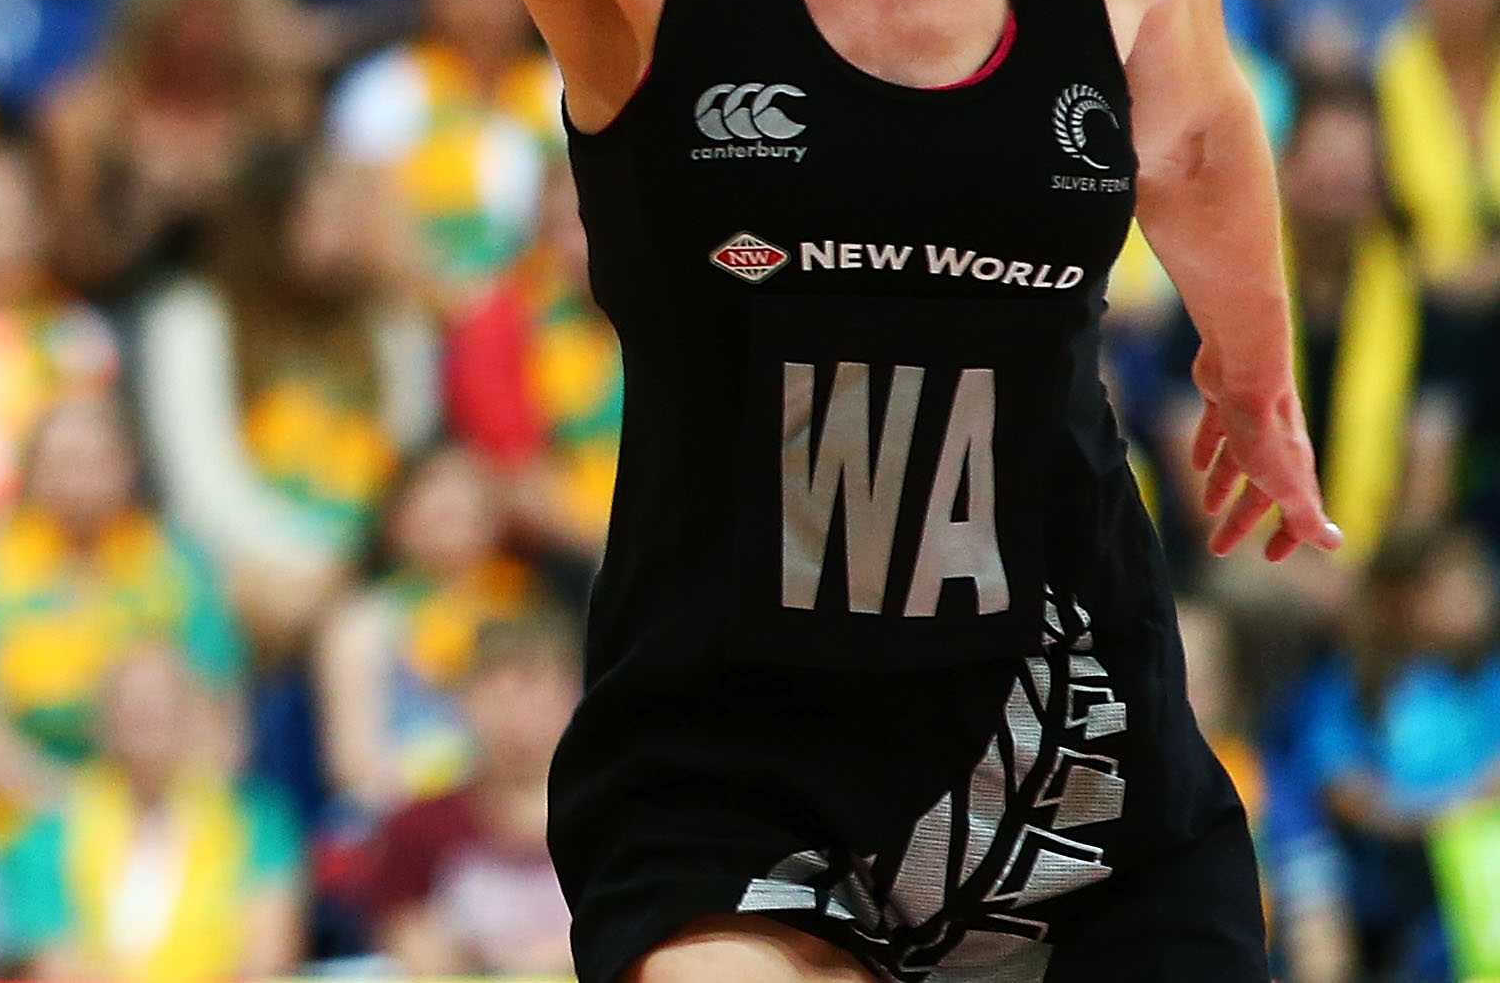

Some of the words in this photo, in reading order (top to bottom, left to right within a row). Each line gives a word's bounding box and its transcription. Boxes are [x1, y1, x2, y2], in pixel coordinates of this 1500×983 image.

[690, 142, 808, 162] canterbury
[1051, 175, 1097, 191] SILVER
[728, 250, 771, 265] NW
[800, 240, 911, 271] NEW
[925, 244, 1084, 290] WORLD
[782, 361, 1011, 617] WA
